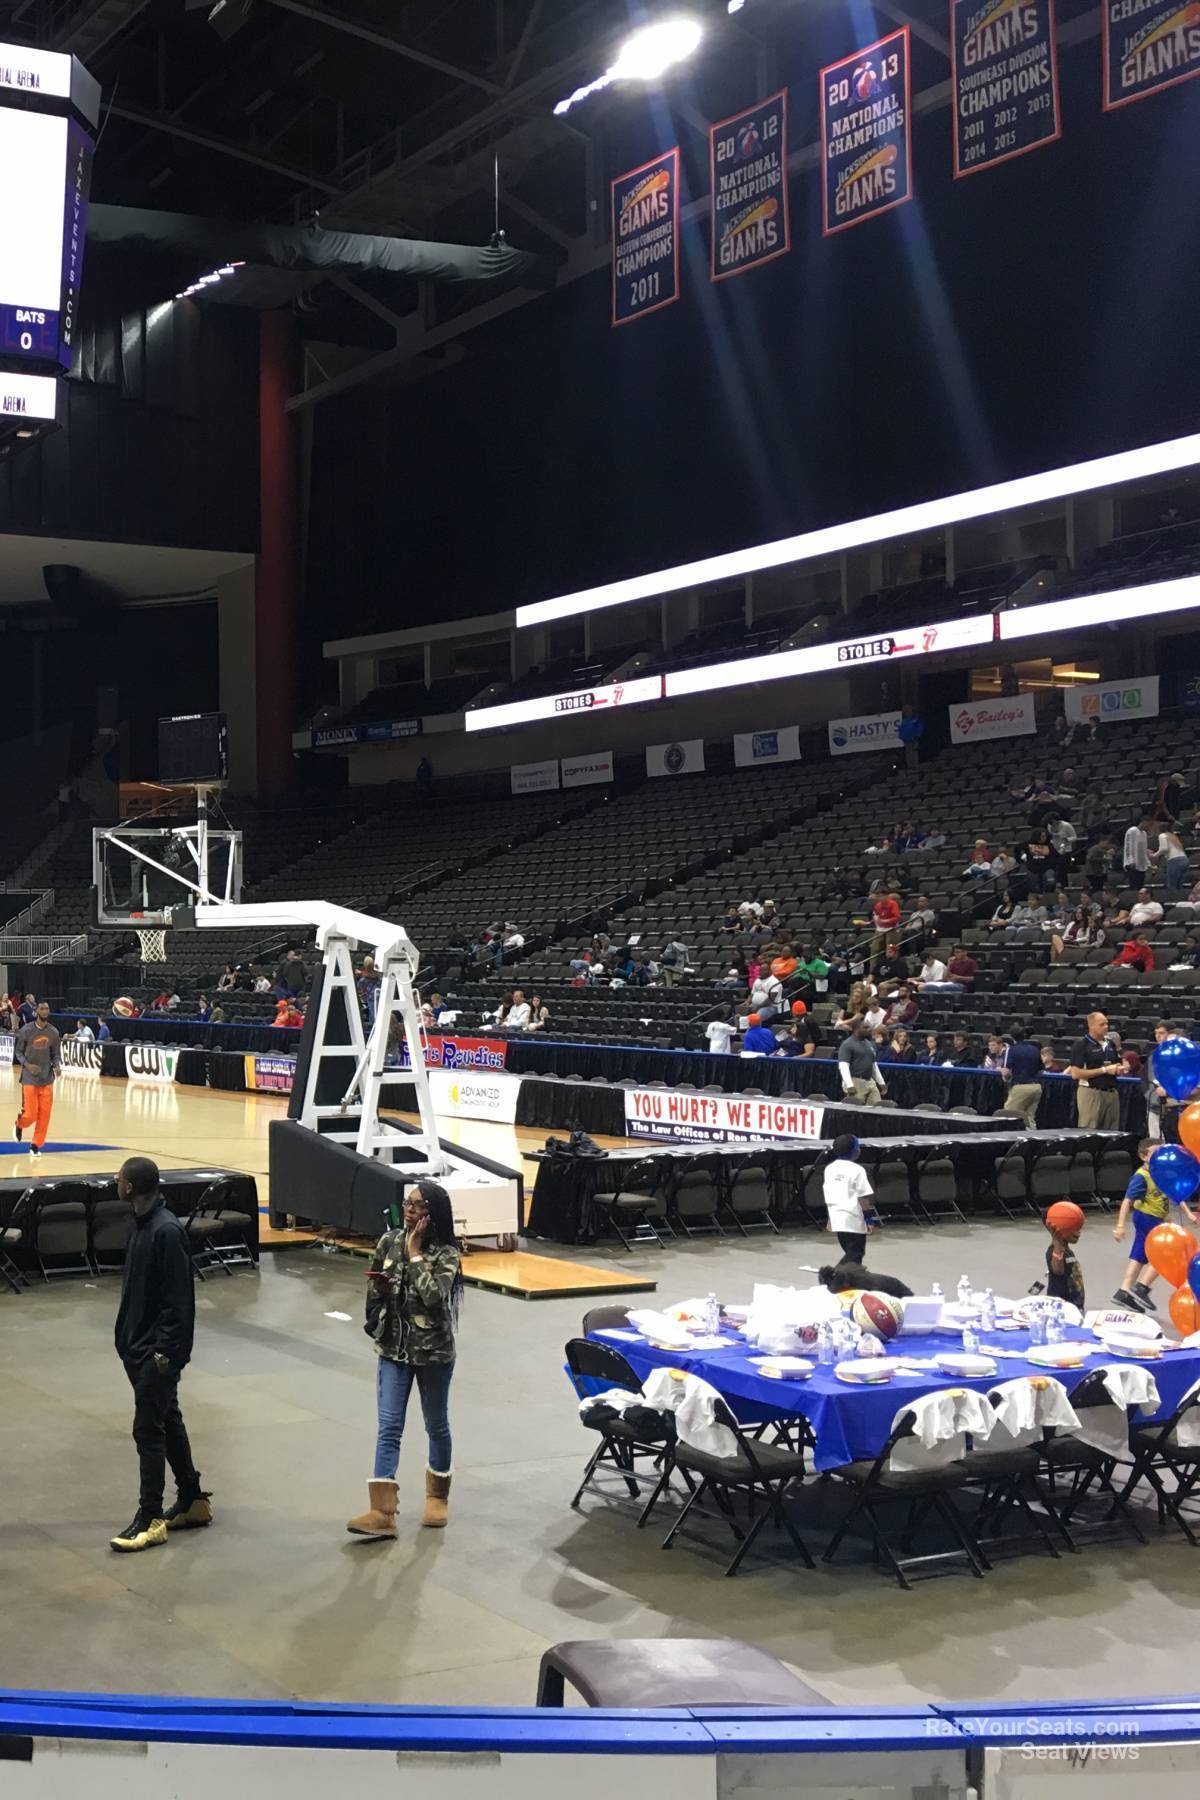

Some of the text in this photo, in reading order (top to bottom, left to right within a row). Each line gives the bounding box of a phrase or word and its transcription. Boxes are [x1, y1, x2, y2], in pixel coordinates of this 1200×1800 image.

[963, 6, 1039, 67] GIANTS
[17, 69, 41, 89] ARENA
[828, 53, 899, 106] 20 13
[960, 41, 1048, 93] SOUTHEAST DIVISION
[960, 60, 1051, 118] CHAMPIONS
[828, 109, 904, 158] CHAMPIONS
[832, 93, 899, 138] NATIONAL
[964, 93, 1050, 141] 2011 2012 2013
[717, 114, 778, 162] 20 12
[716, 167, 781, 210] CHAMPIONS
[720, 152, 778, 191] NATIONAL
[835, 163, 896, 216] GIANTS
[620, 190, 668, 236] GIANTS
[616, 236, 672, 277] CHAMPIONS
[720, 216, 777, 265] GIANTS
[630, 271, 659, 306] 2011
[15, 309, 46, 325] BATS
[20, 332, 32, 350] 0
[3, 395, 26, 413] ARENA
[850, 719, 899, 738] HASTY'S
[976, 707, 1024, 726] Bailey's
[62, 1041, 102, 1069] GIANTS
[442, 1039, 504, 1070] Rowdies
[631, 1121, 649, 1133] The
[652, 1124, 671, 1135] Law
[674, 1126, 709, 1140] Offices
[713, 1132, 724, 1141] of
[727, 1132, 747, 1142] Ron
[634, 1093, 815, 1135] YOU HURT? WE FIGHT!
